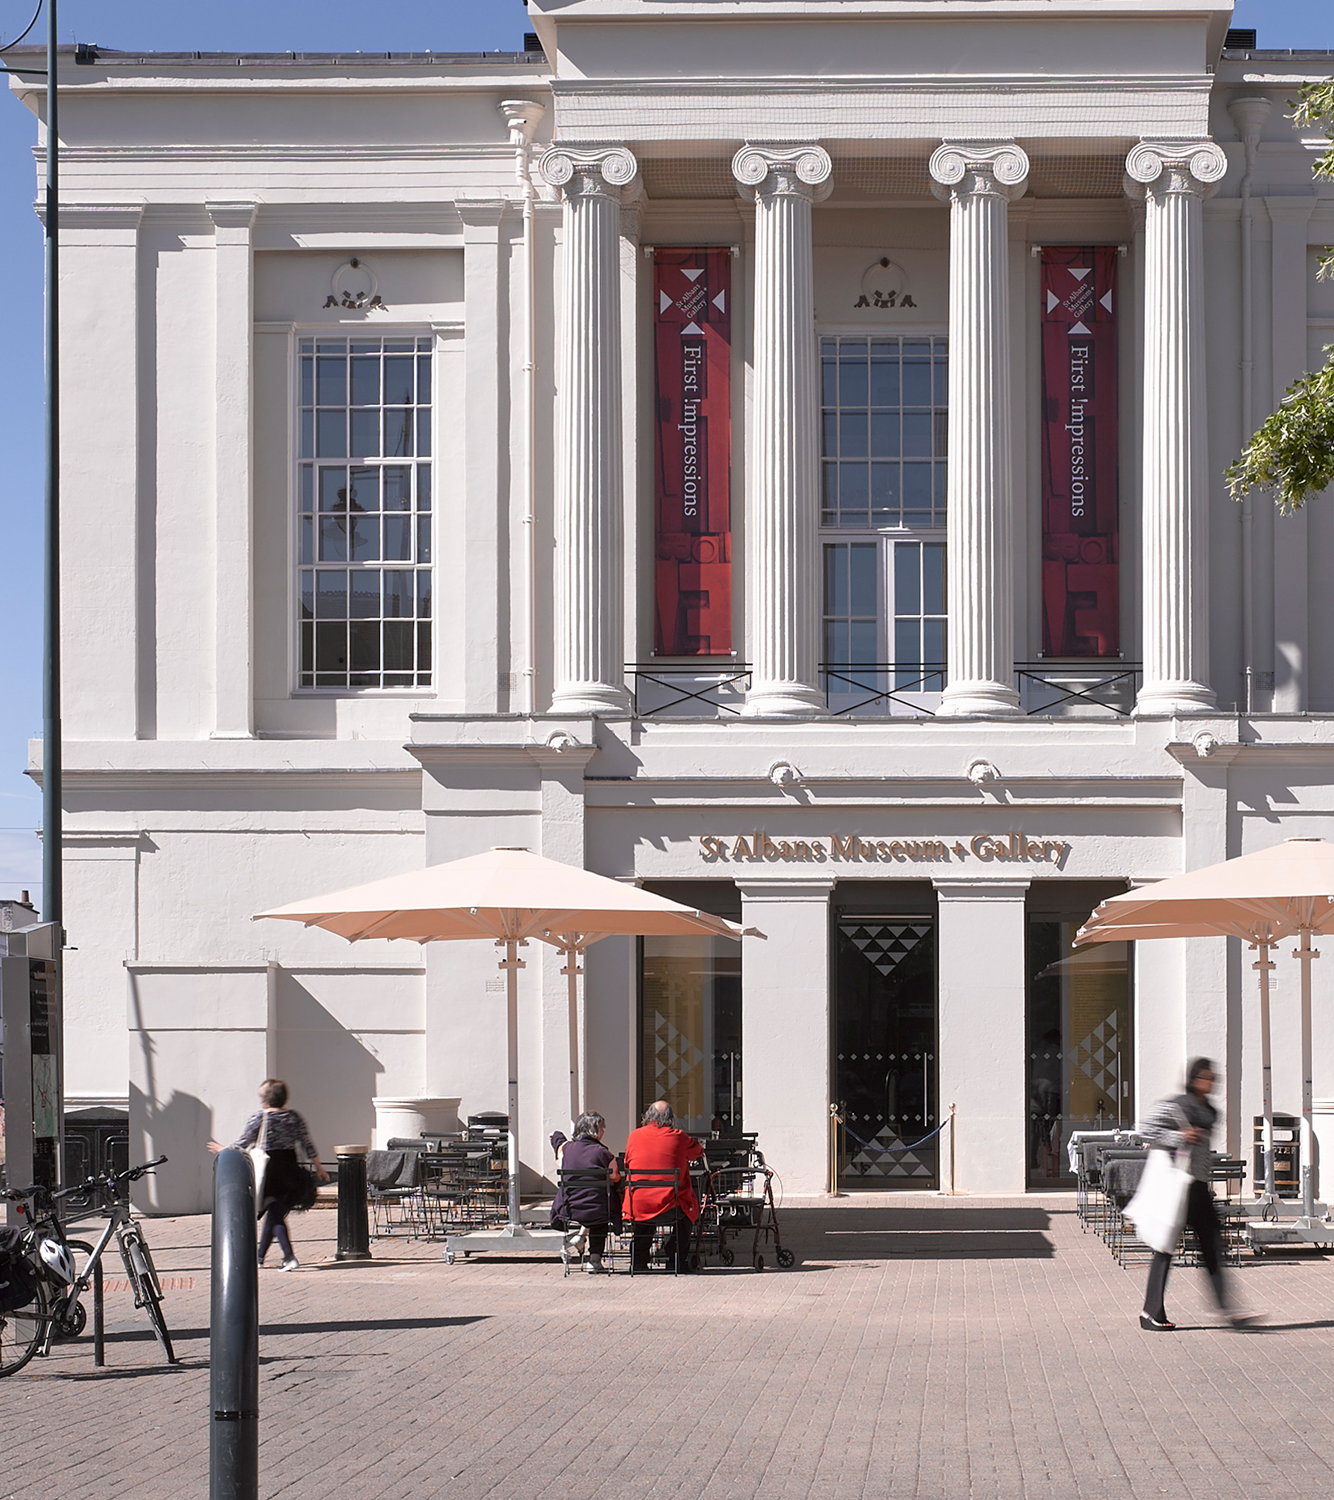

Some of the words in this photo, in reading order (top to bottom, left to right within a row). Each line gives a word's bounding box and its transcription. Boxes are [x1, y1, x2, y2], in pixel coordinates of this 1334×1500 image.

[681, 290, 705, 313] Museum
[682, 284, 700, 302] Albans
[1068, 290, 1092, 312] Museum
[1069, 283, 1087, 302] Albans
[687, 299, 707, 318] Gallery
[1073, 298, 1094, 318] Gallery
[684, 346, 701, 392] First
[1071, 345, 1089, 392] First
[699, 834, 724, 858] St
[731, 832, 821, 858] Albans
[829, 834, 947, 858] Museum
[970, 832, 1066, 865] Gallery
